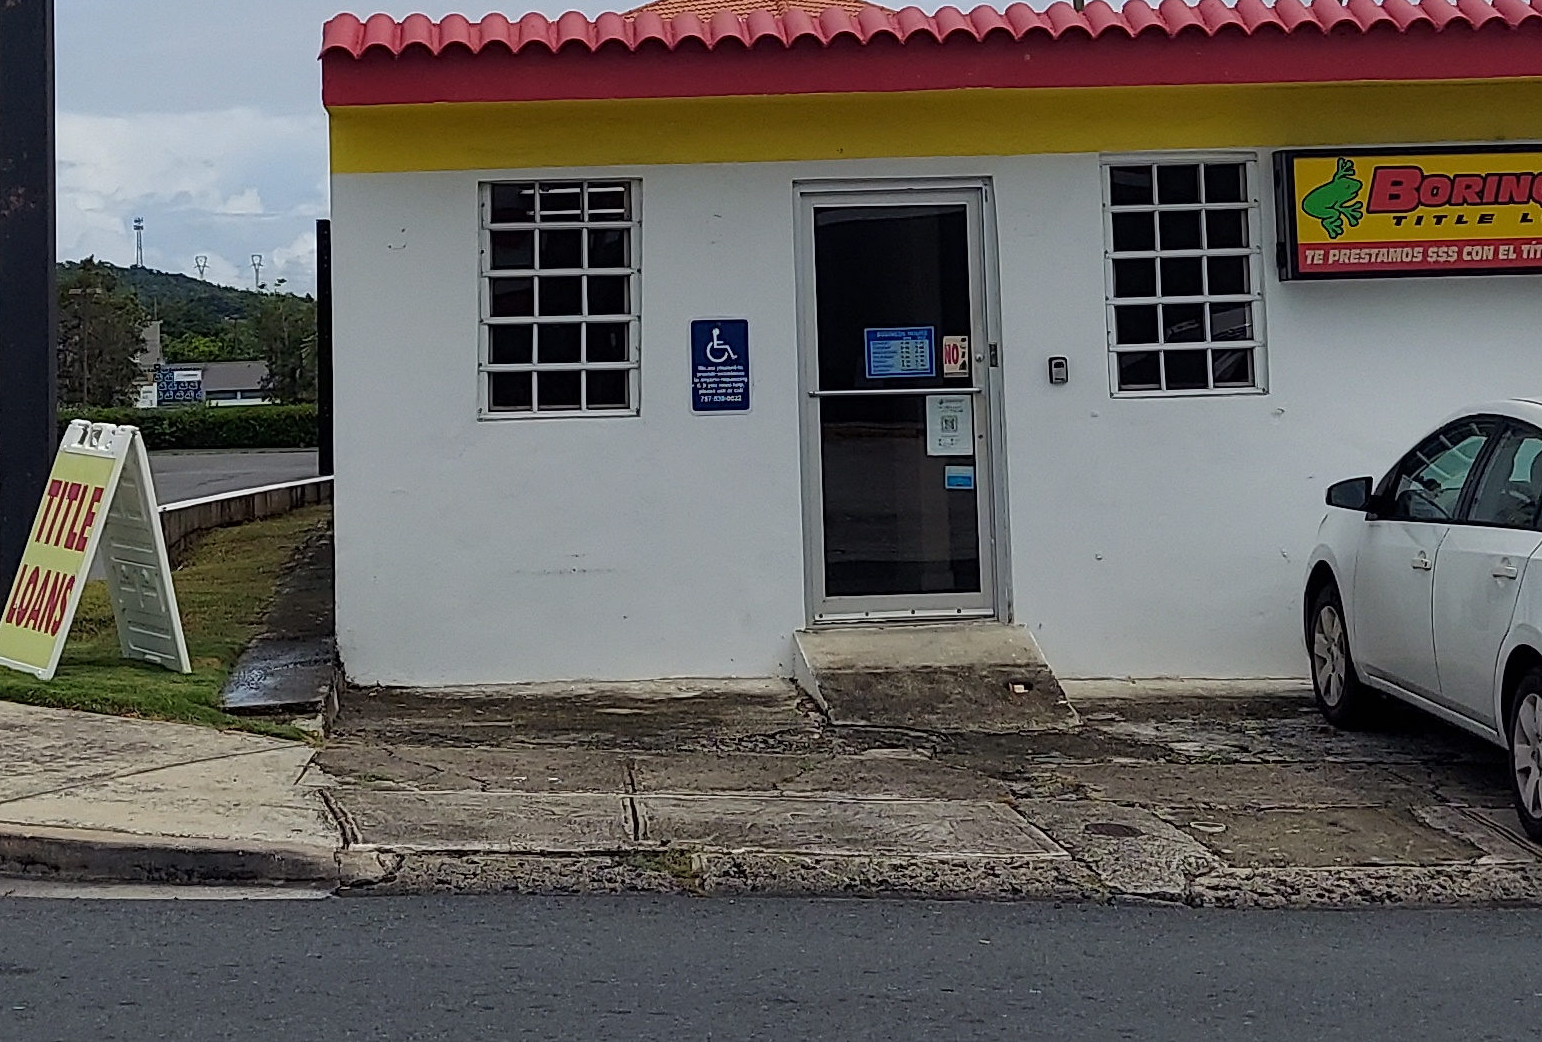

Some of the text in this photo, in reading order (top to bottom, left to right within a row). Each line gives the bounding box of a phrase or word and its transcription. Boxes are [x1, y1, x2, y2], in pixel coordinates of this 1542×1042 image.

[1392, 213, 1495, 227] TITLE
[1305, 249, 1324, 264] TE
[1328, 247, 1423, 264] PRESTAMOS
[1462, 245, 1494, 260] CON
[1498, 244, 1516, 260] EL
[944, 343, 959, 364] NO
[35, 479, 104, 552] TITLE
[6, 563, 75, 637] LOANS
